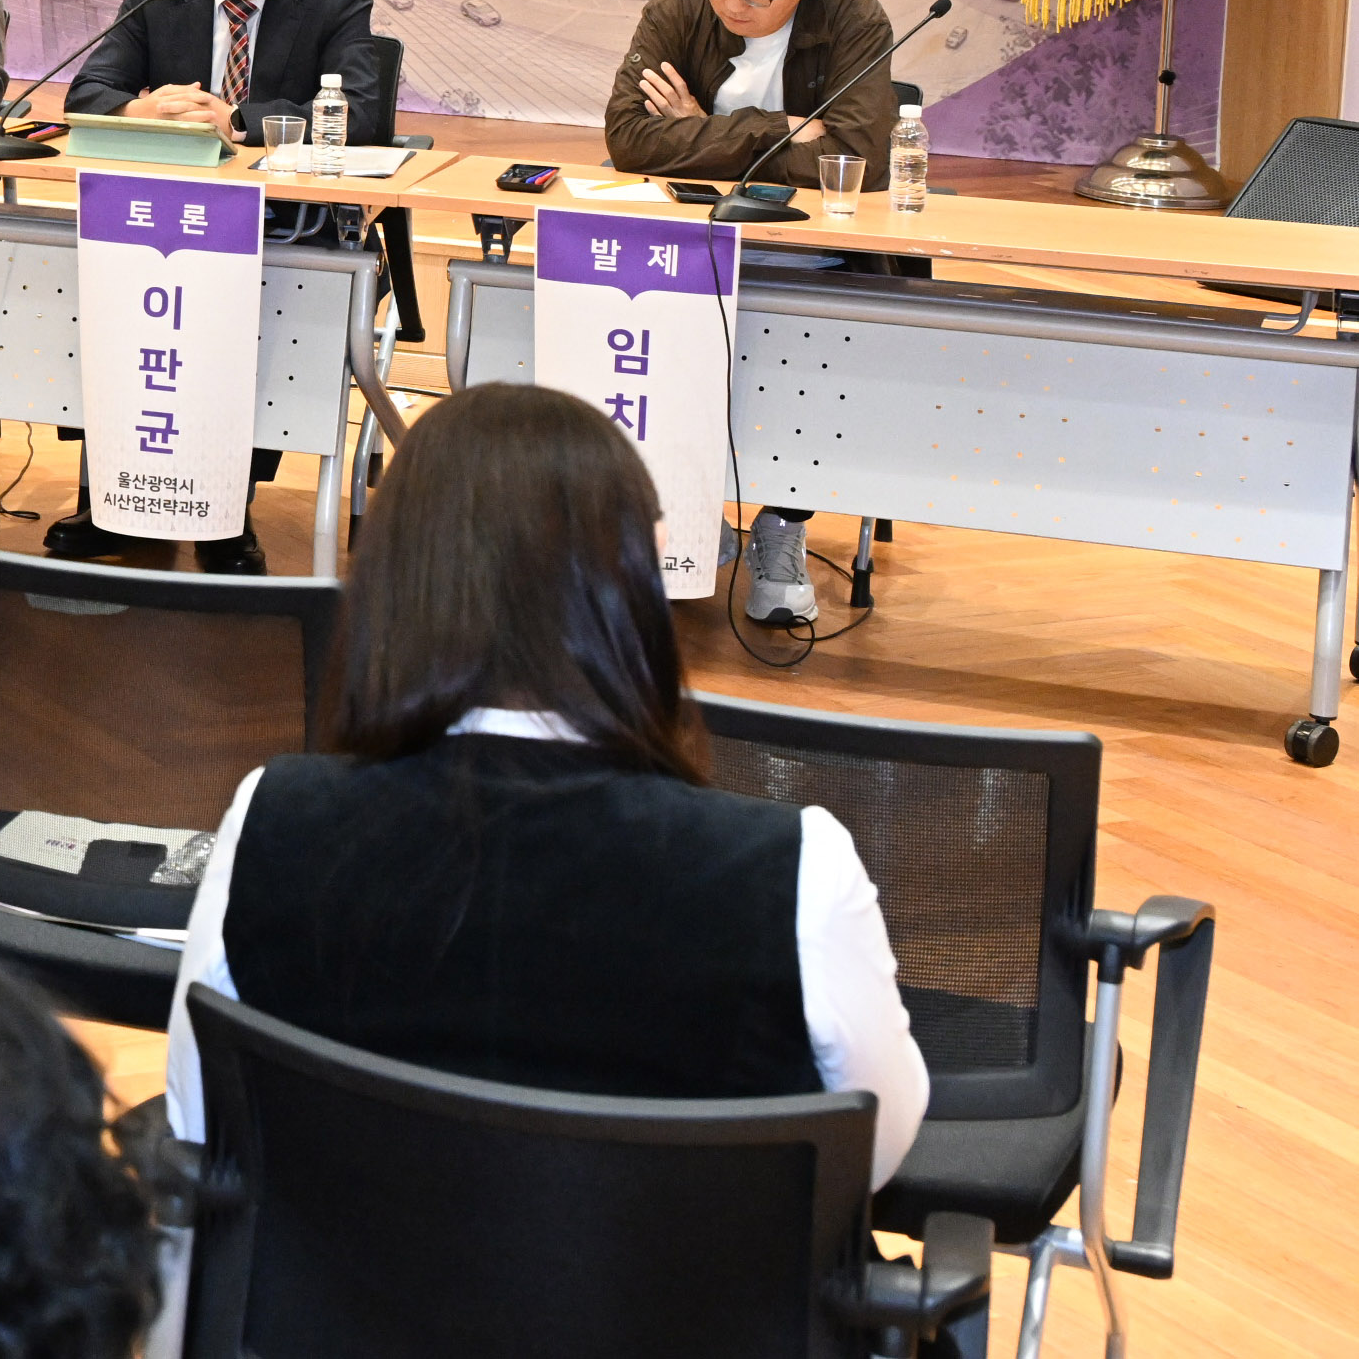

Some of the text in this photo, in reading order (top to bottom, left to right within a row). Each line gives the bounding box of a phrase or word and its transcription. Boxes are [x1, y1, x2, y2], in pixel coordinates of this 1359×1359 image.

[135, 285, 184, 455] 이판균
[117, 471, 195, 496] 울산광역시
[103, 491, 211, 519] AI산업전략과장
[661, 555, 696, 574] 교수
